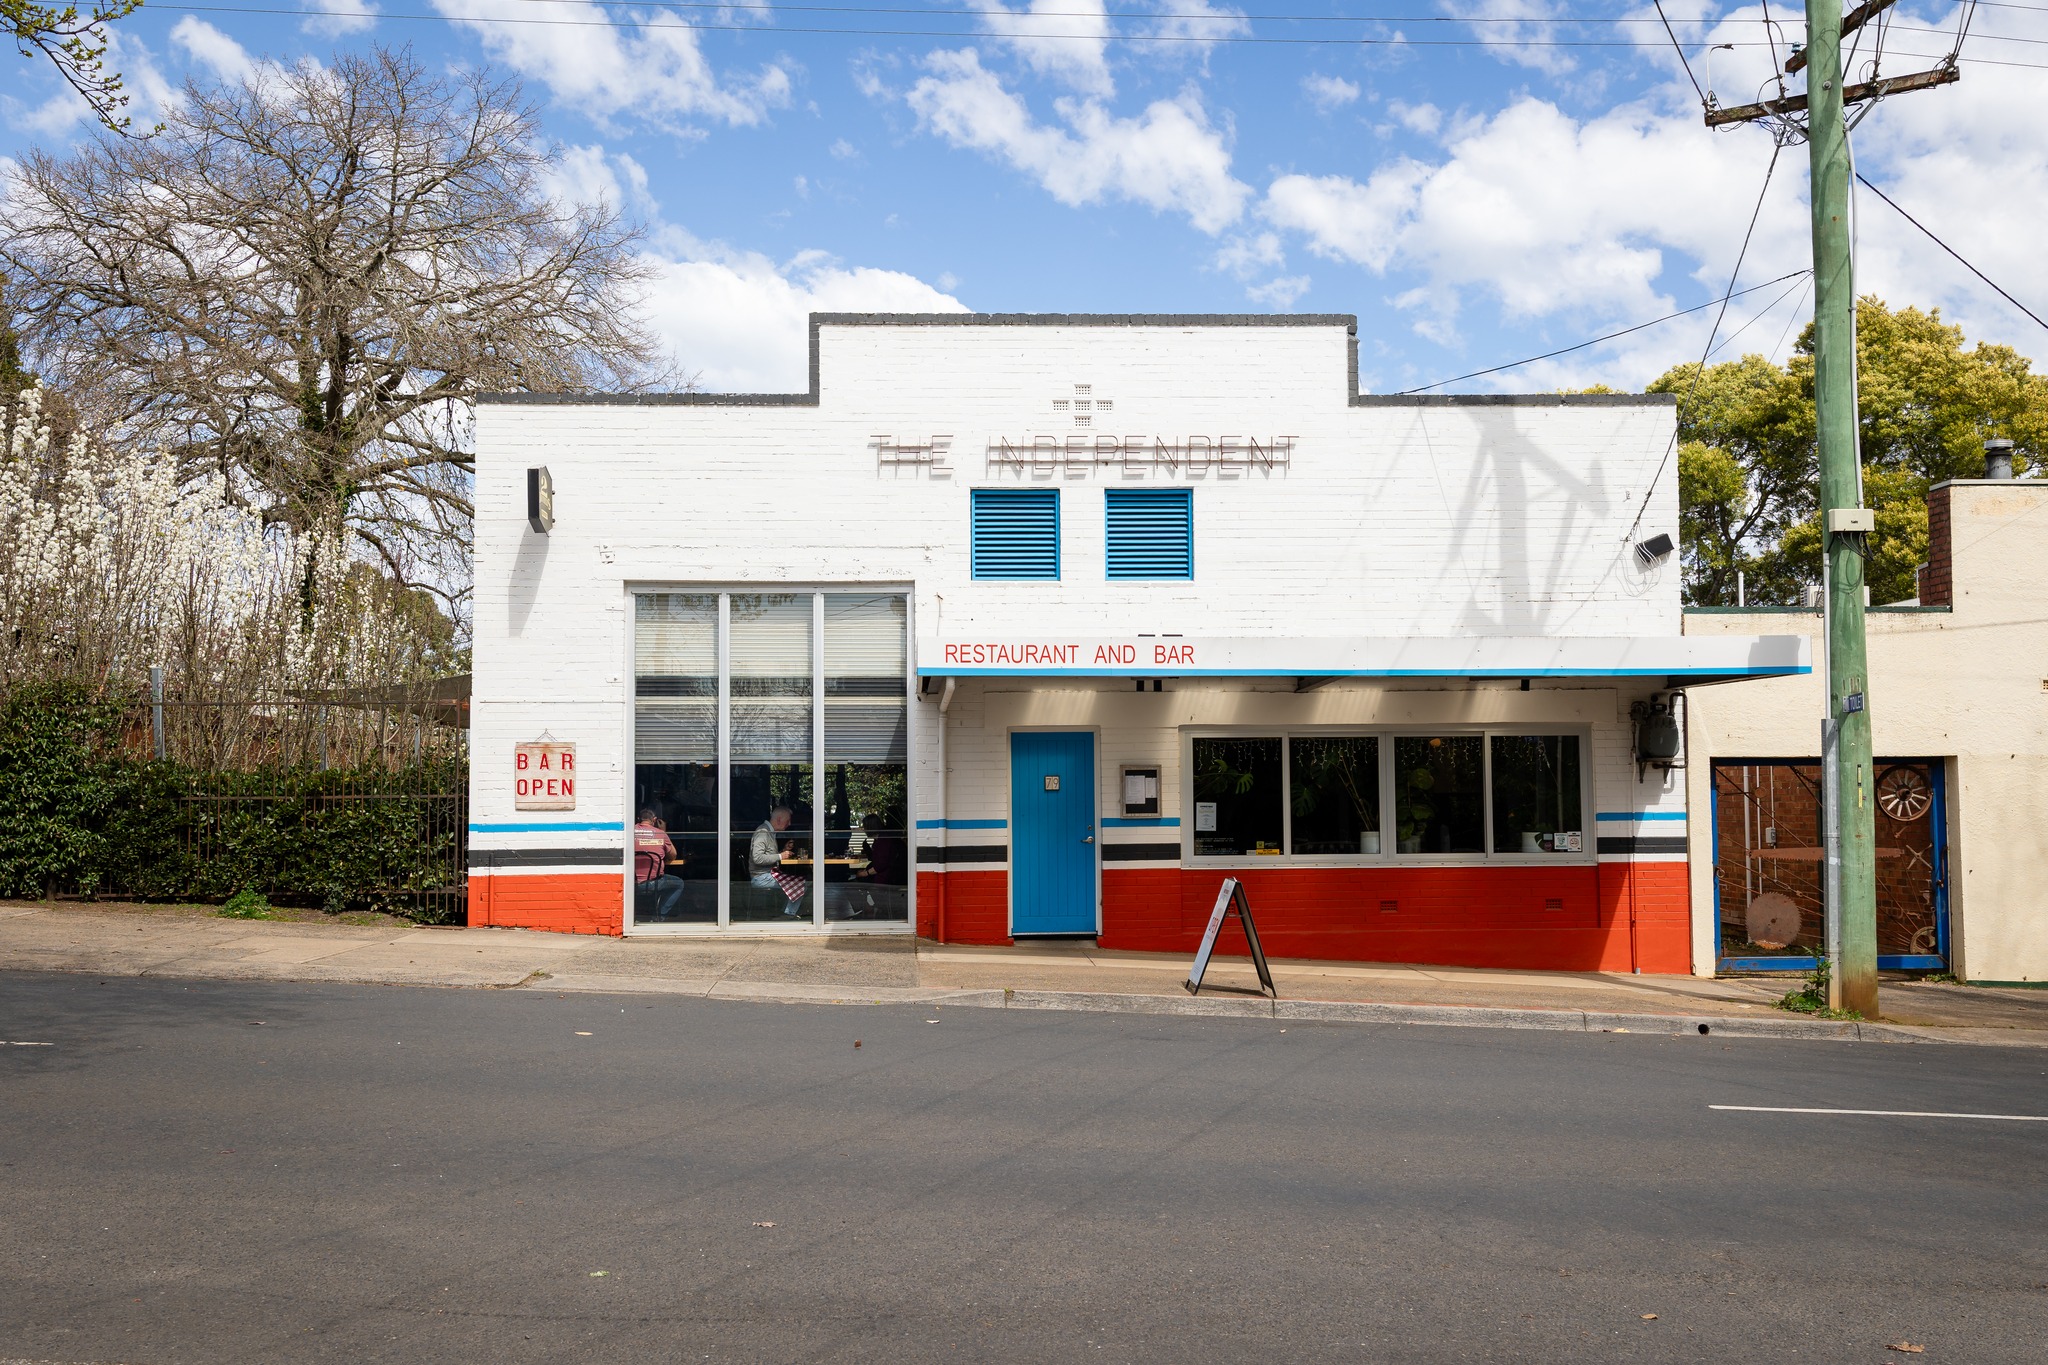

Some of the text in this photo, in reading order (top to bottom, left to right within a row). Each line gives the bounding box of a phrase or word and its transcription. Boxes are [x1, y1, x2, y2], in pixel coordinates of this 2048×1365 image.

[870, 434, 1300, 470] THE INDEPENDENT
[945, 644, 1195, 664] RESTAURANT AND BAR
[517, 753, 573, 770] BAR
[517, 779, 573, 796] OPEN
[1046, 778, 1059, 788] 79
